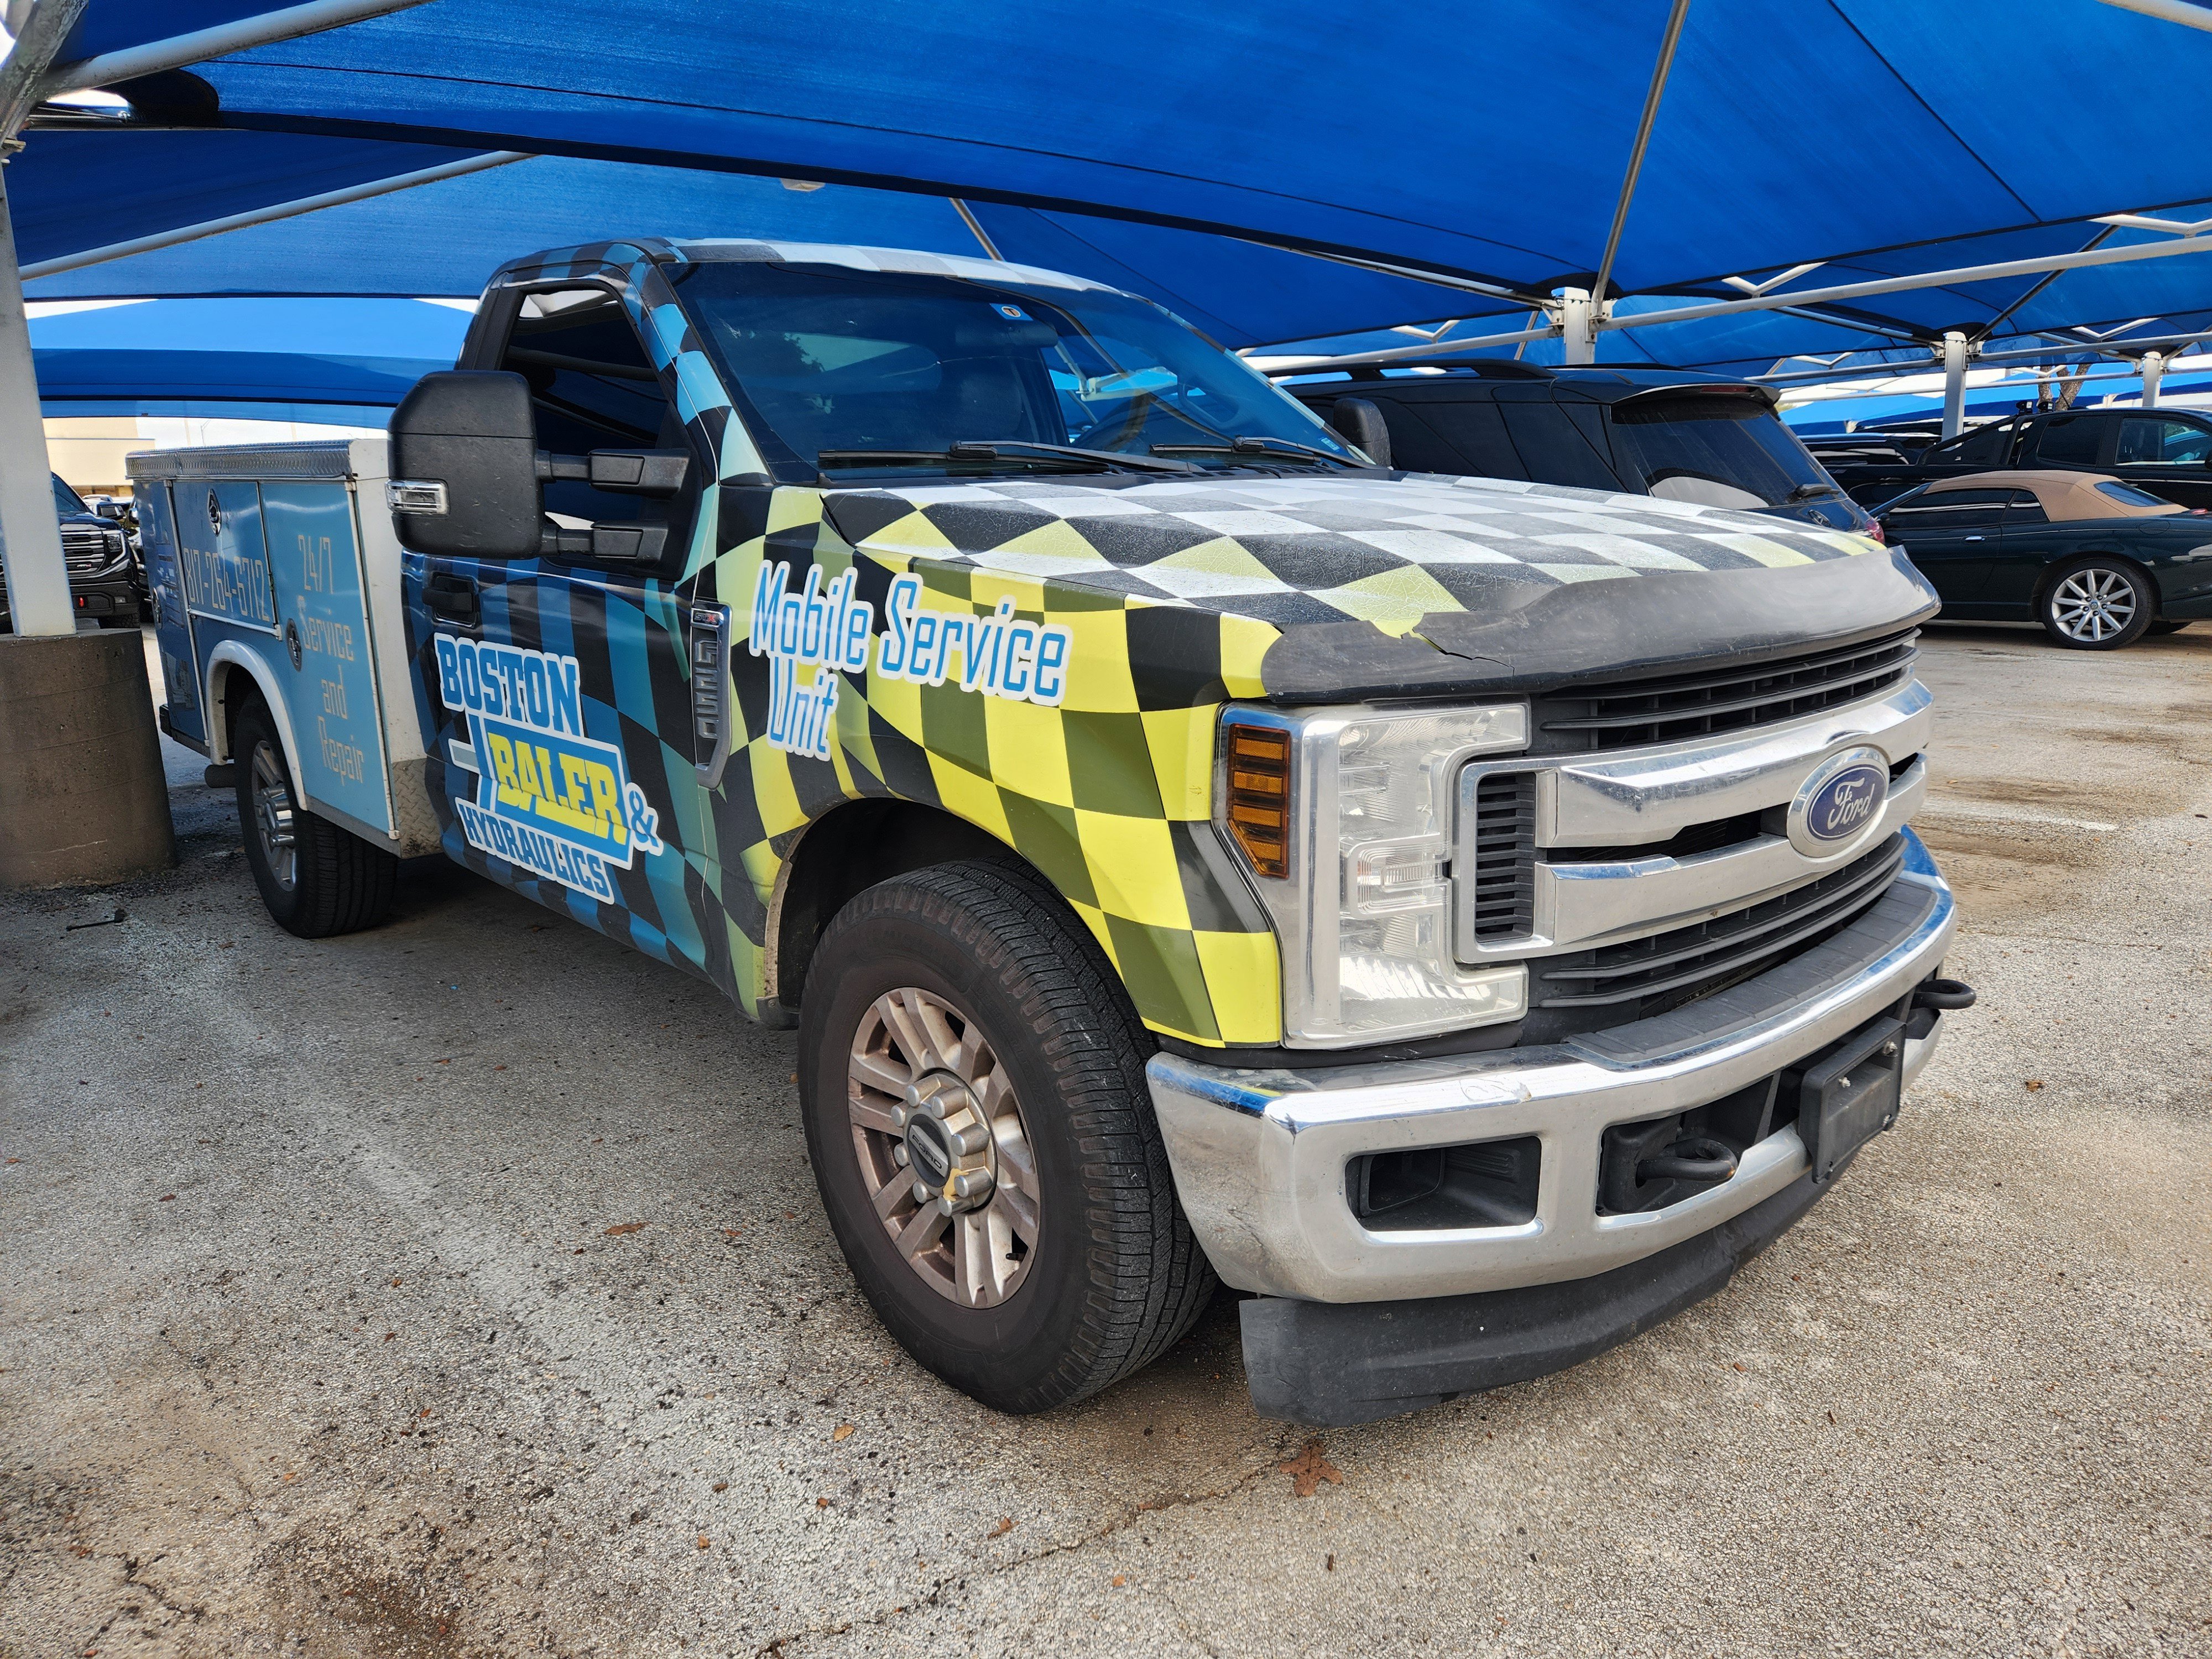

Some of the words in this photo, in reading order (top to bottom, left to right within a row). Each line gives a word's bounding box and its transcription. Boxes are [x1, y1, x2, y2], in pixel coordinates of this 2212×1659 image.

[184, 547, 270, 622] 817-264-6712
[298, 535, 333, 594] 24/7
[298, 595, 354, 661] Service
[695, 613, 717, 624] STX
[753, 567, 869, 665] Mobile
[882, 581, 1066, 697] Service
[321, 665, 348, 719] and
[436, 638, 581, 737] BOSTON
[770, 656, 833, 753] Unit
[318, 716, 364, 786] Repair
[487, 732, 628, 846] BALER
[629, 791, 659, 847] &
[1828, 778, 1875, 830] Ford
[458, 803, 608, 897] HYDRAULICS
[912, 1134, 942, 1170] FORD
